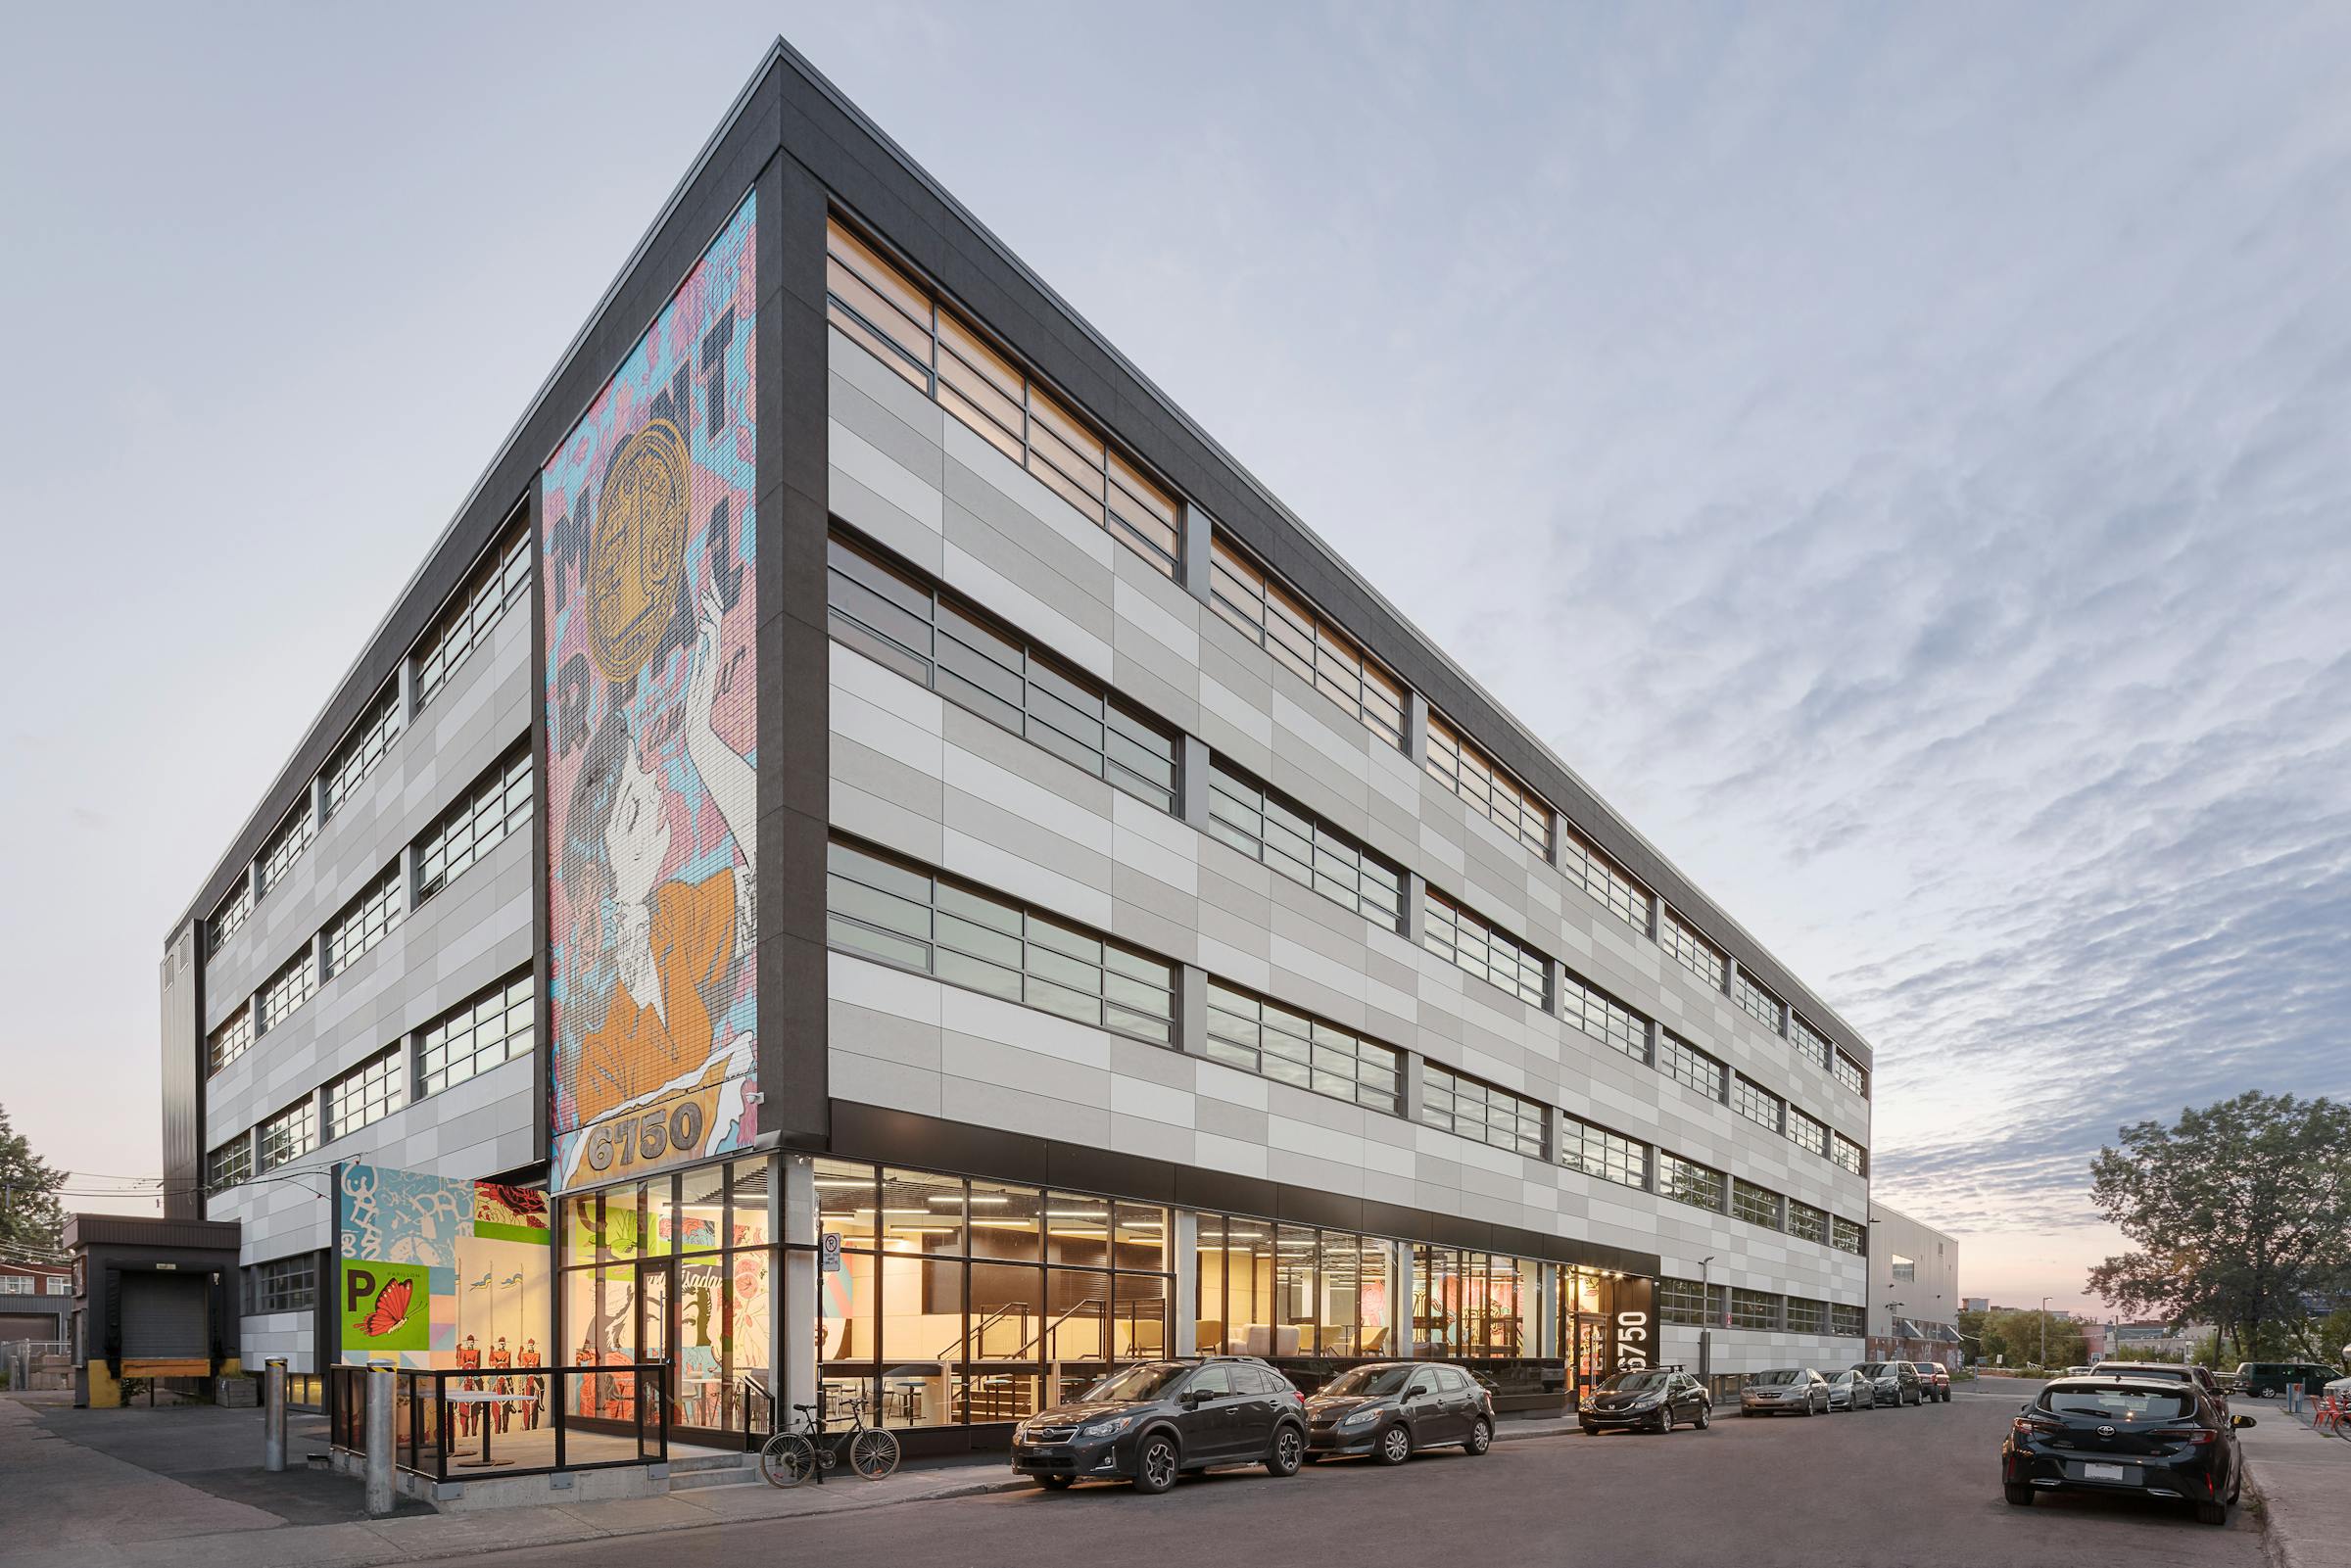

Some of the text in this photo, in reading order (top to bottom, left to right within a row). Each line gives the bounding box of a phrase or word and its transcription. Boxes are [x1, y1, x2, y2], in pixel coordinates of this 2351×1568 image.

[588, 1102, 702, 1170] 6750
[348, 1269, 375, 1311] P
[1617, 1311, 1648, 1371] 6750
